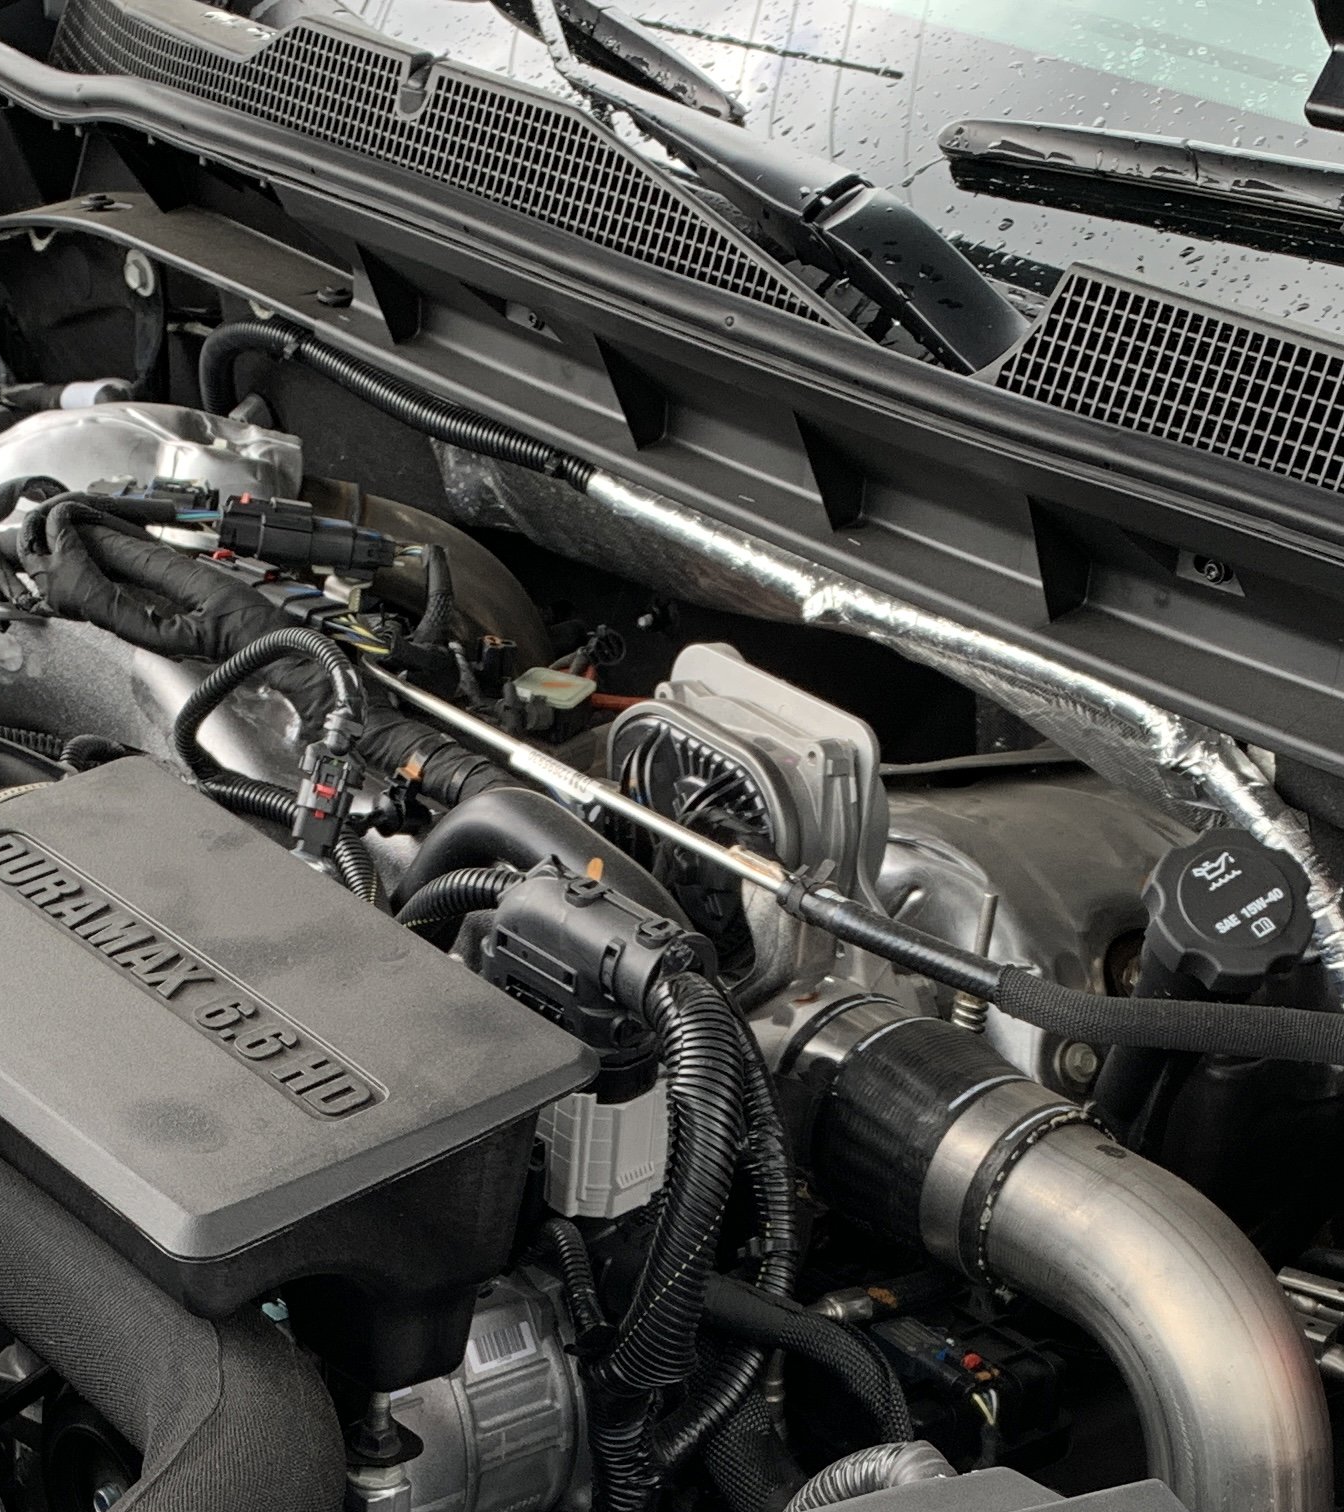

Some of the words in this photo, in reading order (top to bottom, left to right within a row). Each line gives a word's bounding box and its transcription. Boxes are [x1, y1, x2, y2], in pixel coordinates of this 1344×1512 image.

[1214, 913, 1241, 934] SAE
[1240, 887, 1284, 919] 15W-40
[194, 997, 301, 1061] 6.6
[270, 1053, 374, 1115] HD
